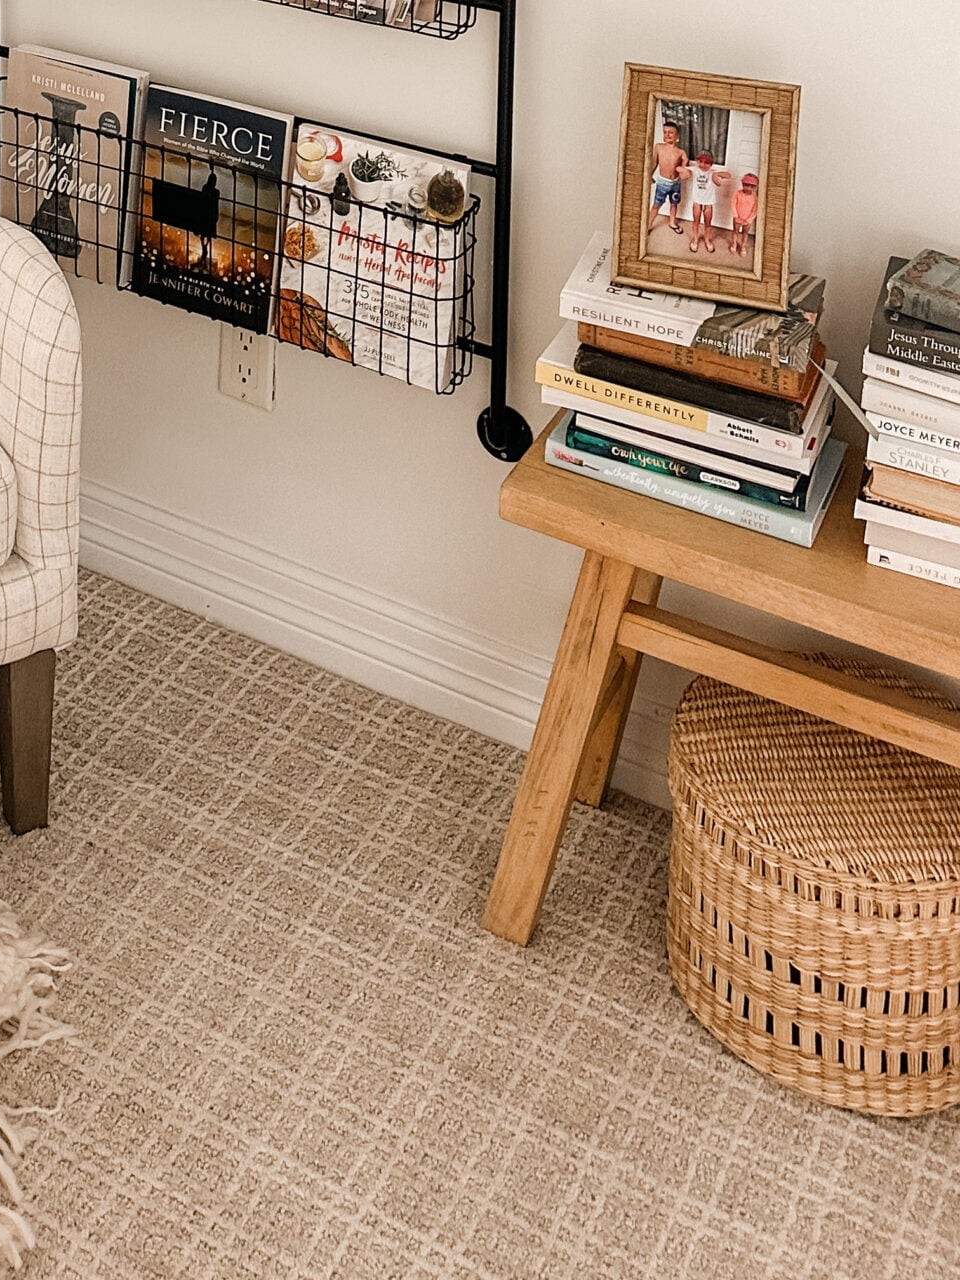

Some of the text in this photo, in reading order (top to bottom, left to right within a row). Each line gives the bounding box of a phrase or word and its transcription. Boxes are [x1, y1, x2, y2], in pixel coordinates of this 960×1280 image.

[31, 74, 105, 102] KRISTI MCLELLAND
[8, 120, 88, 168] Jesus
[158, 107, 273, 161] FIERCE
[221, 151, 241, 164] Changed
[250, 160, 265, 169] World
[37, 156, 115, 214] Women
[148, 271, 201, 298] JENNIFER
[204, 289, 254, 315] COWART
[343, 280, 370, 299] 375
[369, 314, 406, 332] WELNESS
[572, 306, 684, 339] RESILIENT HOPE
[888, 328, 918, 345] Jesus
[371, 349, 396, 362] PUSELL
[695, 336, 772, 359] CHRISTINE CAINE
[887, 344, 929, 363] Middle
[554, 373, 695, 422] DWELL DIFFERENTLY
[880, 402, 938, 423] JOANNA GAINES
[726, 422, 753, 435] Abbott
[730, 430, 760, 444] Schmitz
[878, 420, 960, 449] JOYCE MEYER
[611, 446, 637, 462] own
[637, 452, 667, 469] your
[889, 451, 949, 478] STANLEY
[897, 447, 934, 464] CHARLES
[702, 474, 738, 489] CLARKSON
[664, 487, 711, 511] uniquely
[713, 503, 736, 517] you
[741, 517, 770, 532] MEYER
[742, 508, 770, 522] JOYCE
[907, 563, 947, 581] PEACE
